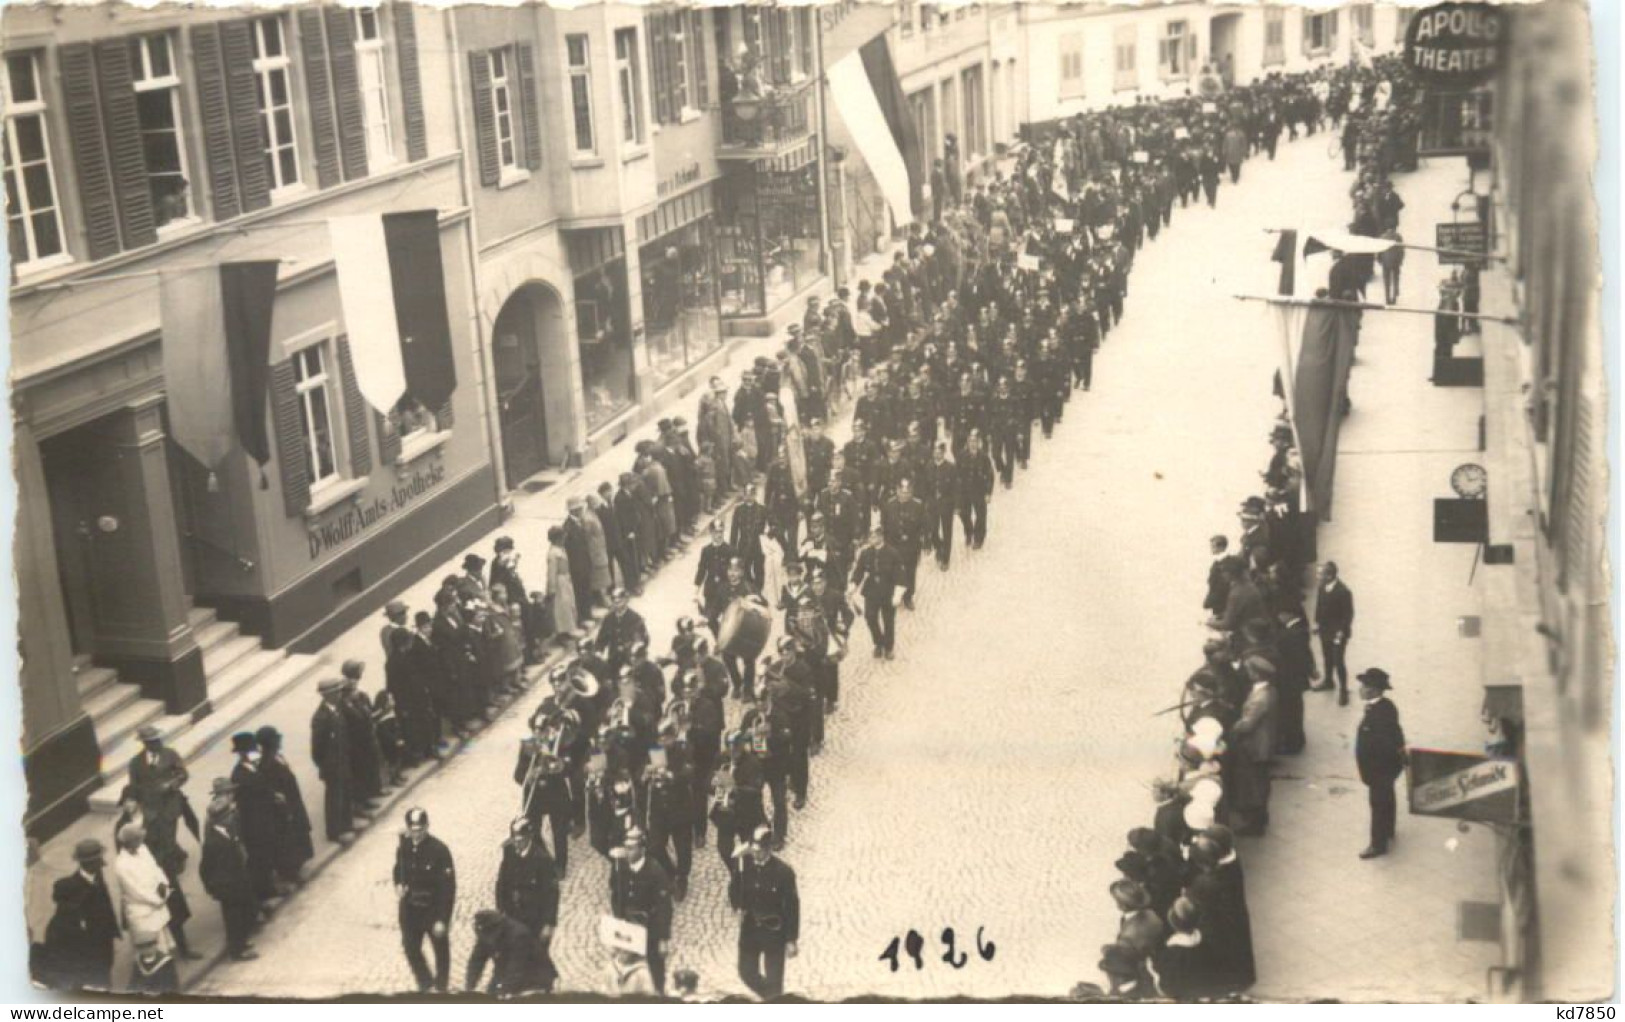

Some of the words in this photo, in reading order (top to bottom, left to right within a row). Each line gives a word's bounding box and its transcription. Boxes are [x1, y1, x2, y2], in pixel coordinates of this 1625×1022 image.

[1416, 9, 1500, 42] APOLLO
[1413, 46, 1497, 71] THEATER
[878, 925, 996, 972] 1926
